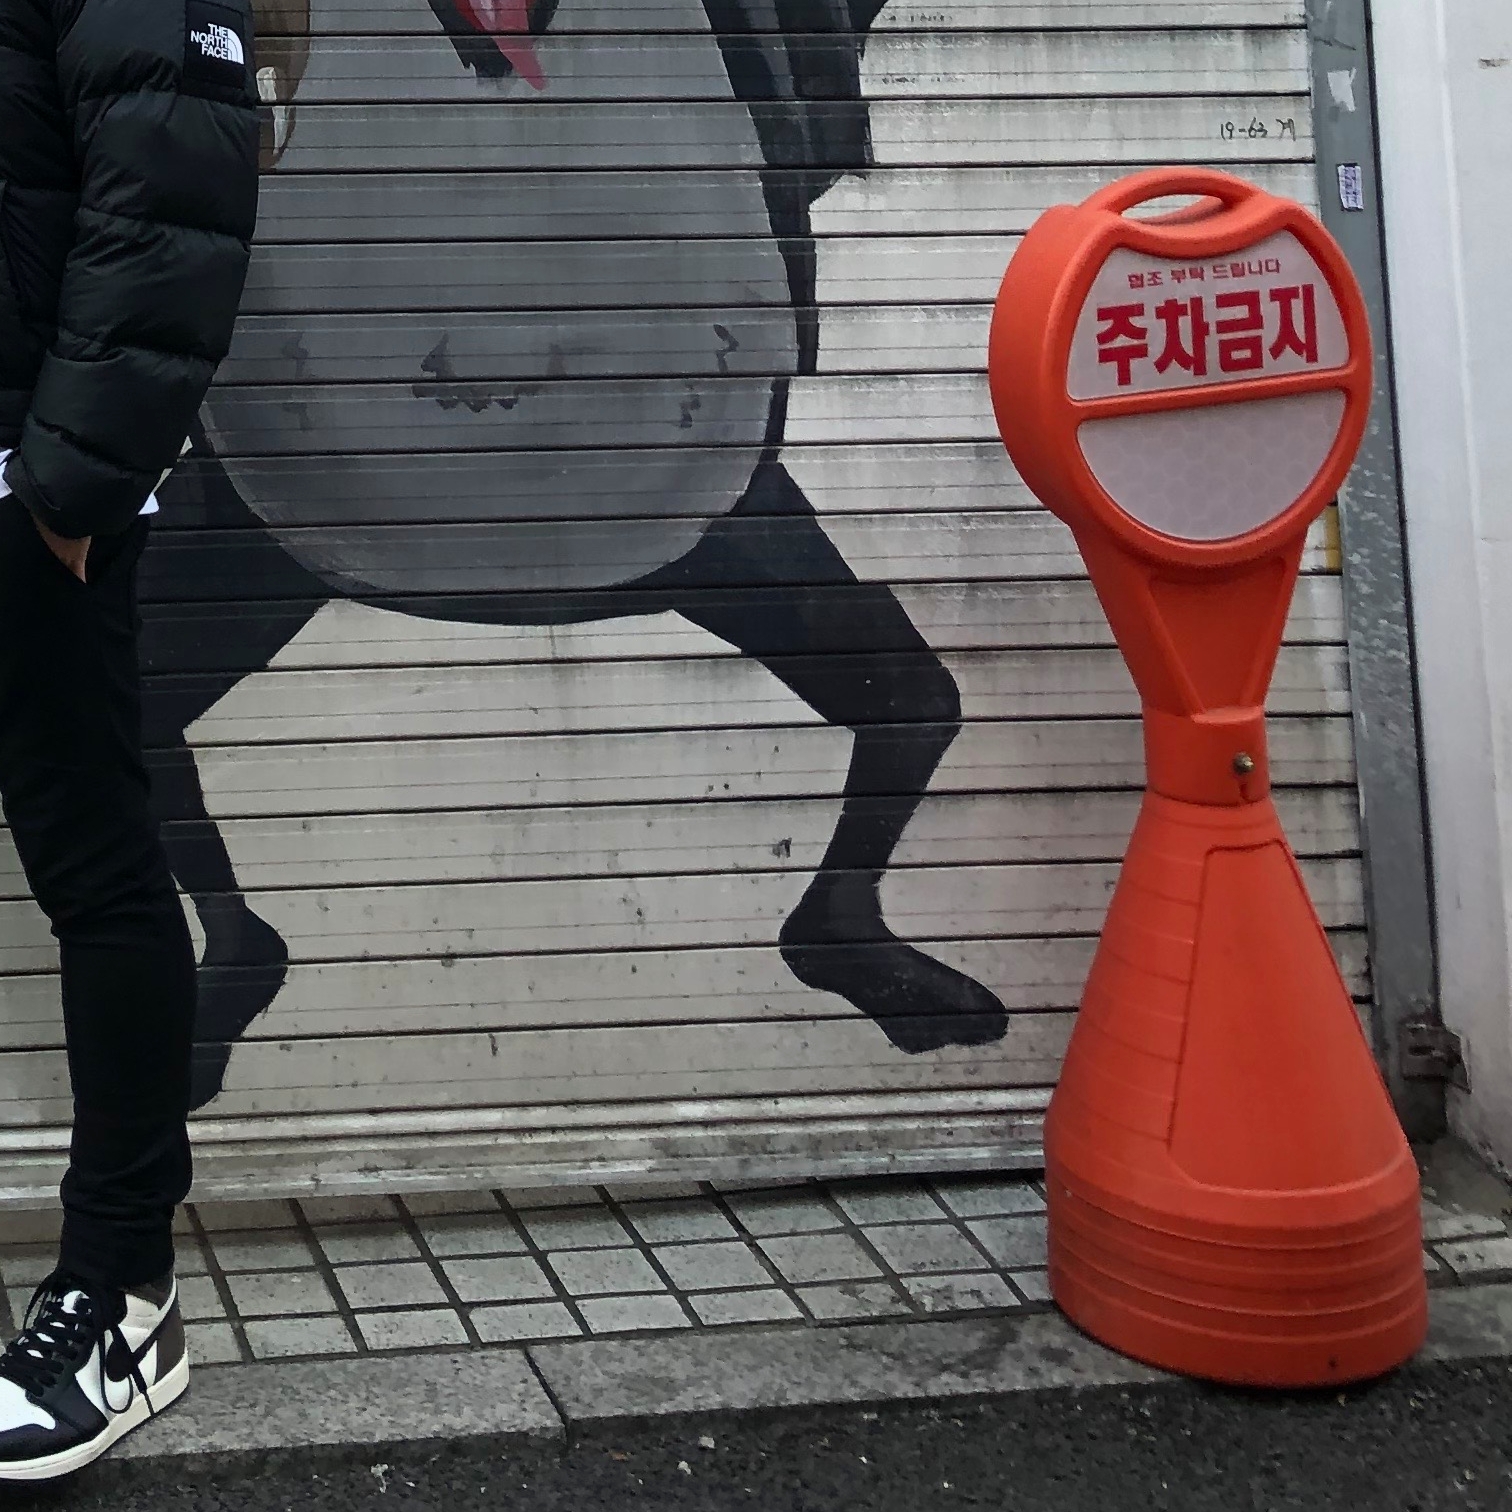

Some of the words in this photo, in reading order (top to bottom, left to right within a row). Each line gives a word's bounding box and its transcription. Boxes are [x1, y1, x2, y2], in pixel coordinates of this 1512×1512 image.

[190, 29, 228, 49] NORTH
[207, 22, 228, 38] THE
[201, 43, 228, 60] FACE
[1212, 257, 1281, 279] 드립니다
[1095, 283, 1319, 387] 주차금지
